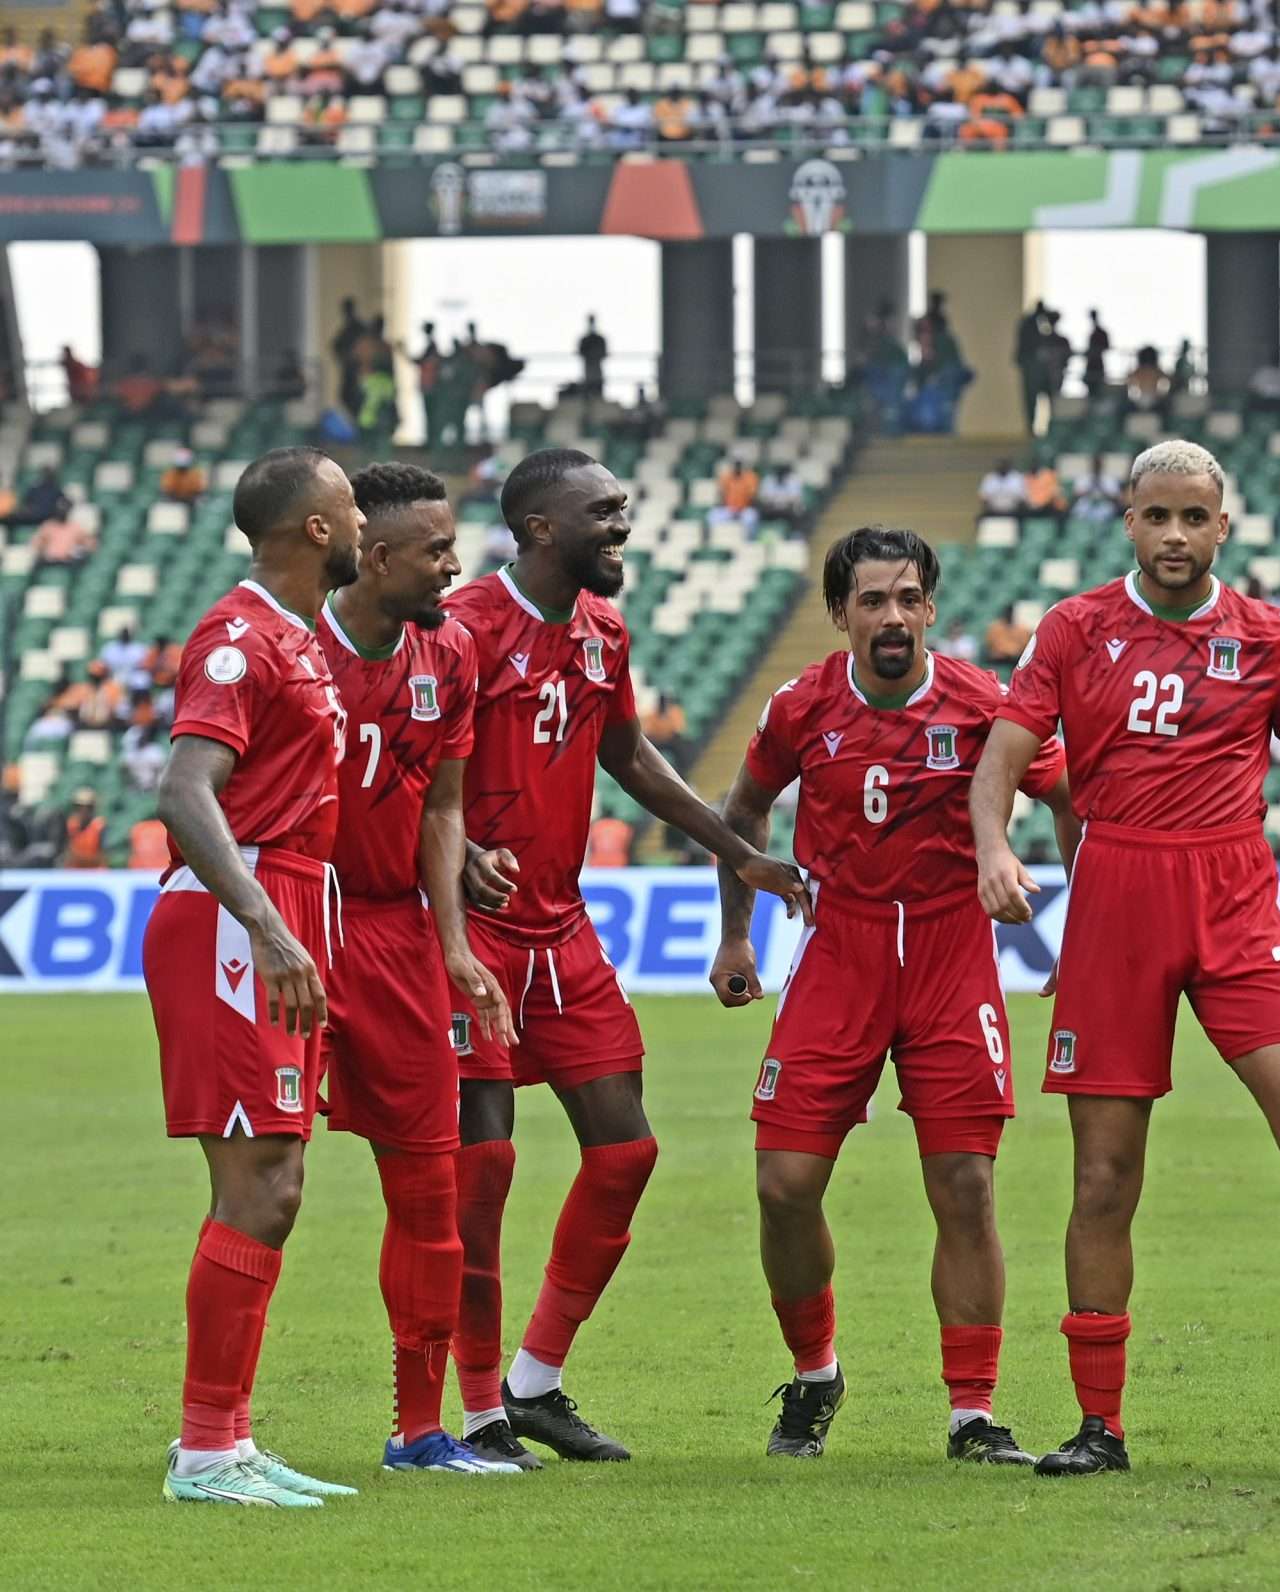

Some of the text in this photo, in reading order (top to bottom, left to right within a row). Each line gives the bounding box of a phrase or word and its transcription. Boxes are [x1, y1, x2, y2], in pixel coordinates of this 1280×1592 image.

[533, 680, 568, 744] 21
[1127, 670, 1184, 736] 22
[359, 723, 382, 788] 7
[864, 765, 889, 823] 6
[978, 1003, 1004, 1064] 6
